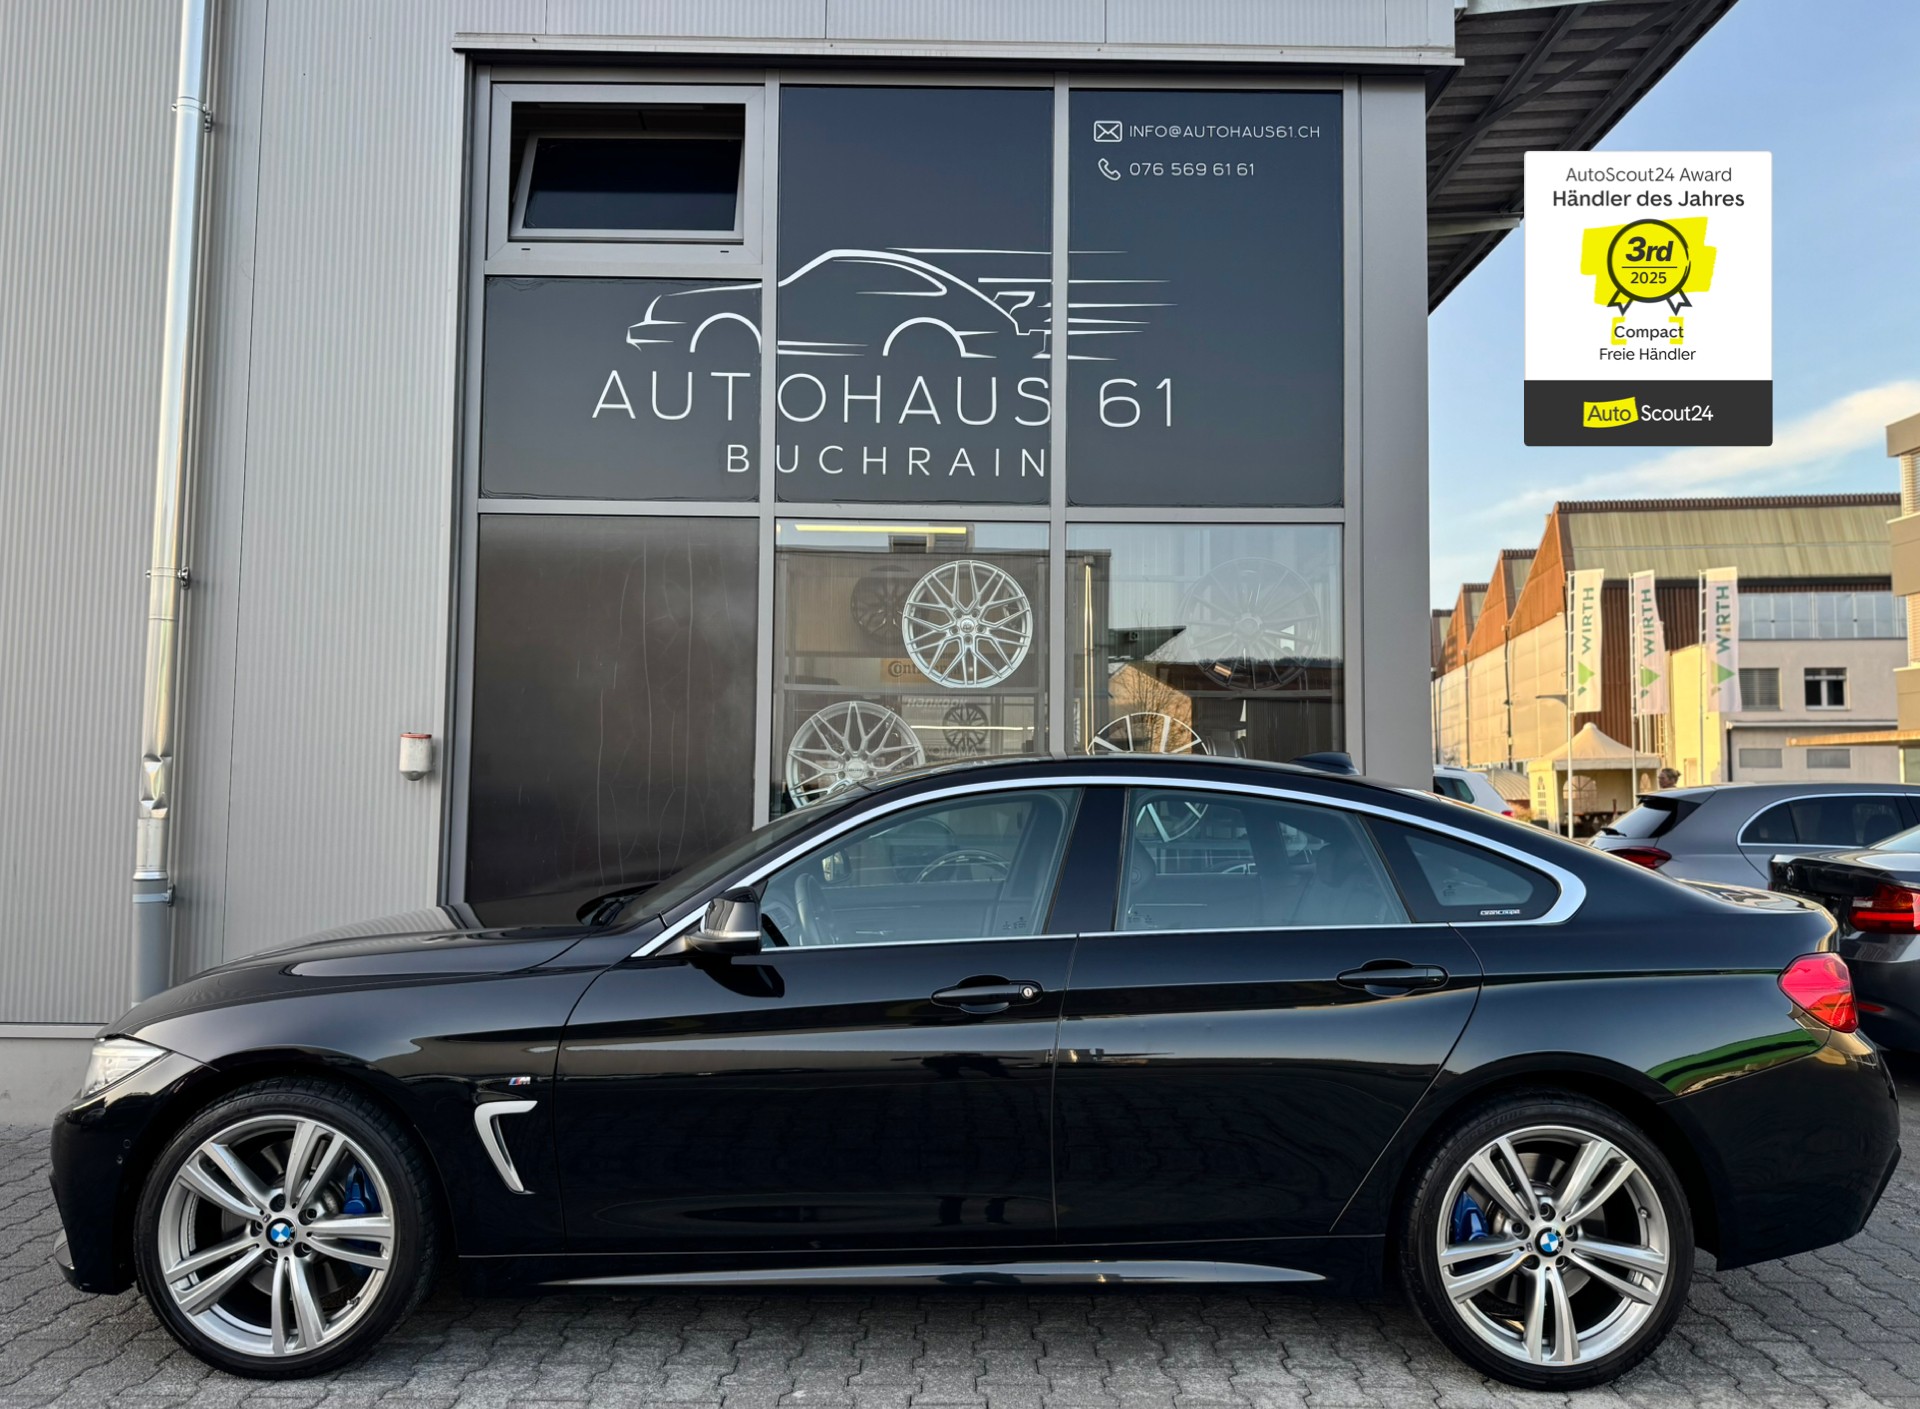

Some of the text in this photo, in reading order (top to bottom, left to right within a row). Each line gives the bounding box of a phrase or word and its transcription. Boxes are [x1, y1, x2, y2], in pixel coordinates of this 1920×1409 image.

[1129, 125, 1320, 138] INFO@AUTOHAUS61.CH
[1129, 162, 1255, 176] 076 569 61 61
[592, 369, 1171, 428] AUTOHAUS 61
[727, 444, 1045, 477] BUCHRAIN
[1582, 587, 1594, 655] WIRTH
[1641, 588, 1655, 657] WIRTH
[1716, 585, 1731, 655] WIRTH
